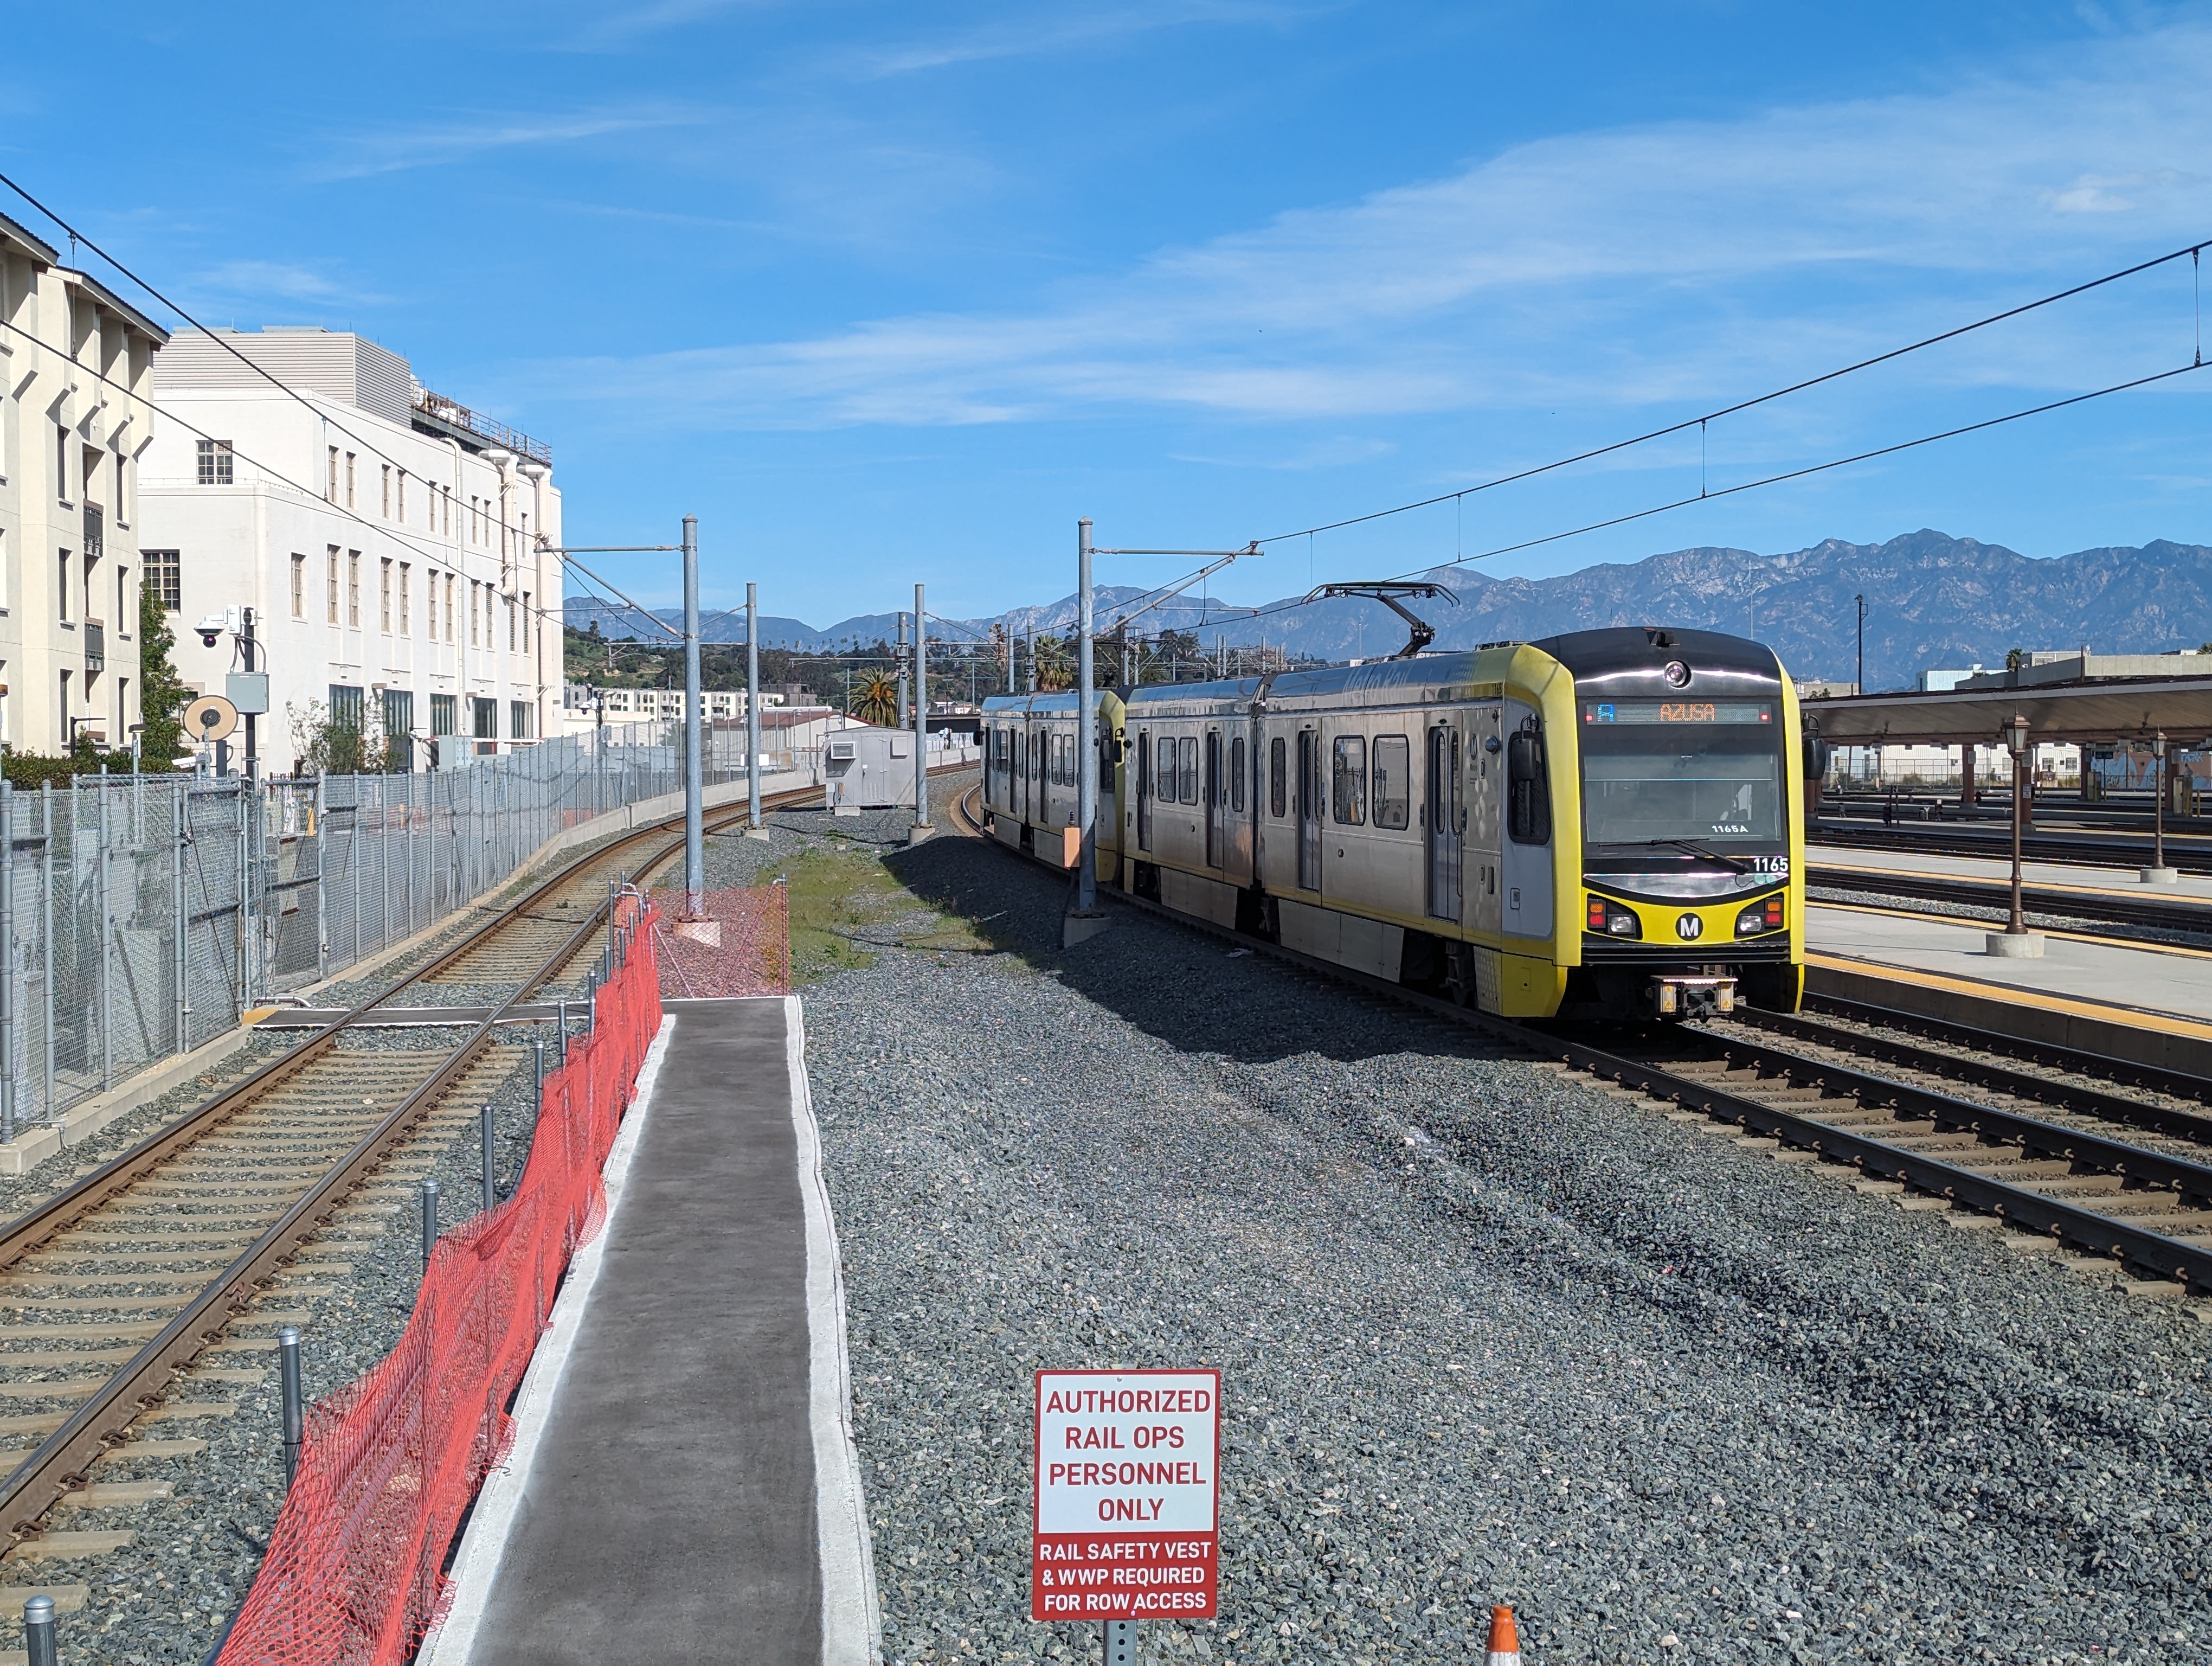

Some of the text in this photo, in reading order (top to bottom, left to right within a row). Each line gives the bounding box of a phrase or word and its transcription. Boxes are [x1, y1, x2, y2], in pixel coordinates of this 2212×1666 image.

[1660, 703, 1716, 722] AZUSA
[1712, 825, 1749, 833] 1165A
[1753, 858, 1788, 872] 1165
[1681, 918, 1699, 937] M
[1046, 1391, 1210, 1413] AUTHORIZED
[1066, 1426, 1184, 1449] RAIL OPS
[1050, 1462, 1206, 1485] PERSONNEL
[1099, 1498, 1163, 1521] ONLY
[1040, 1542, 1211, 1560] RAIL SAFETY VEST
[1042, 1567, 1204, 1587] & WWP REQUIRED
[1045, 1592, 1206, 1611] FOR ROW ACCESS
